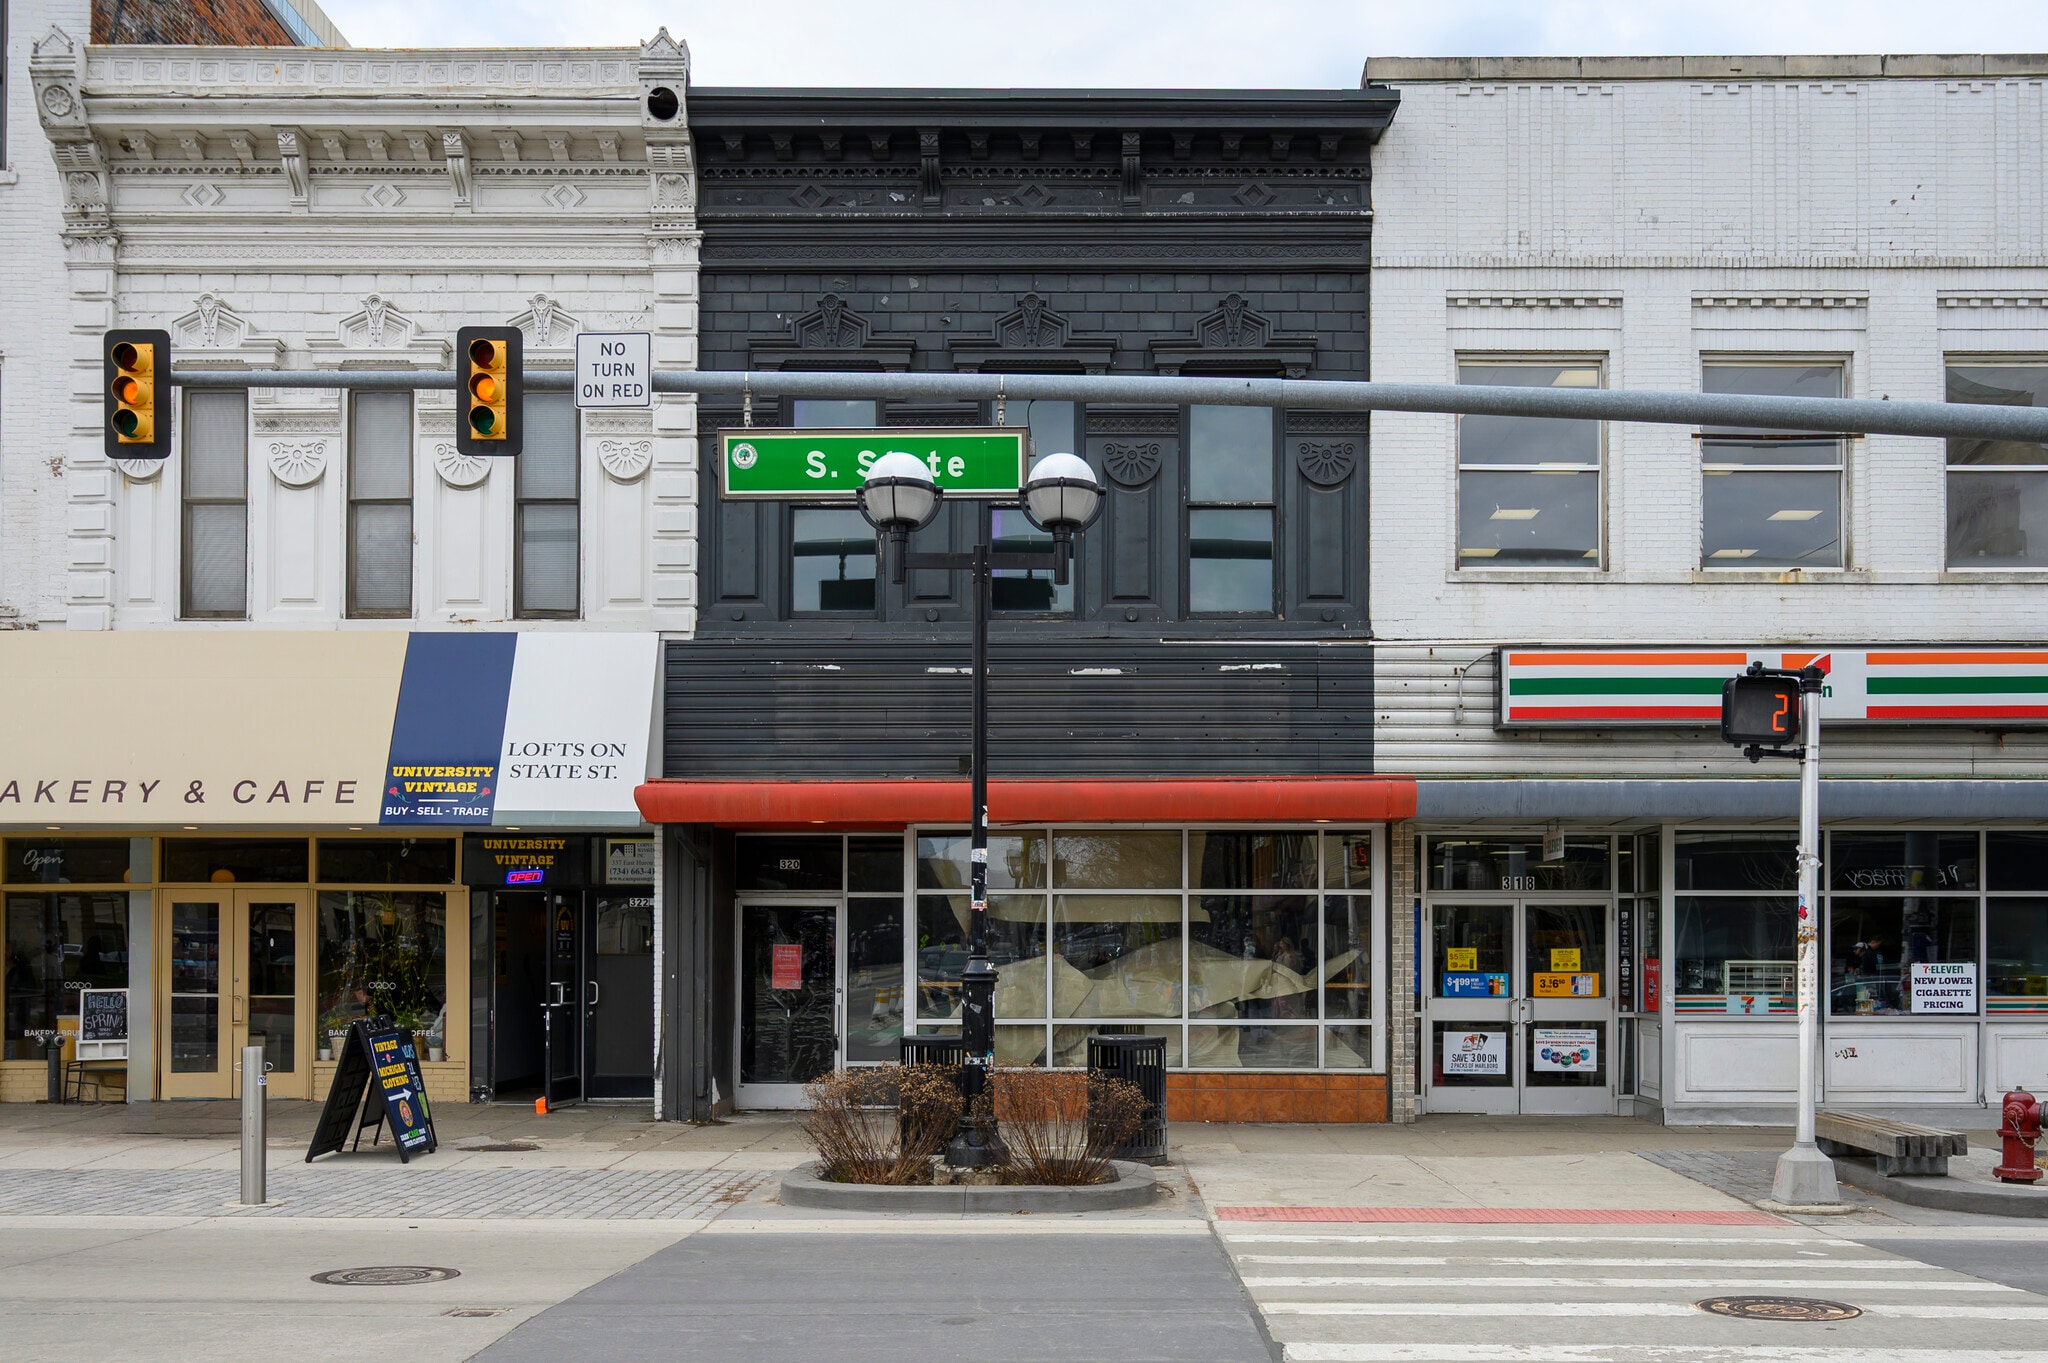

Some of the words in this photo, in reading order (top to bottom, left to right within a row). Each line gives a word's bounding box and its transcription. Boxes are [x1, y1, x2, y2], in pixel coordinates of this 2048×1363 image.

[601, 342, 626, 356] NO
[592, 363, 635, 377] TURN
[583, 384, 604, 398] ON
[612, 384, 643, 397] RED
[805, 450, 838, 479] S.
[856, 450, 966, 479] Ste
[1772, 693, 1788, 732] 2
[507, 742, 585, 758] LOFTS
[590, 743, 627, 758] ON
[392, 766, 494, 778] UNIVERSITY
[509, 764, 583, 779] STATE
[587, 765, 618, 779] ST.
[183, 779, 206, 804] &
[232, 779, 358, 804] CAFE
[404, 781, 478, 793] VINTAGE
[384, 806, 409, 816] BUY
[416, 806, 444, 816] SELL
[452, 806, 490, 816] TRADE
[483, 839, 566, 850] UNIVERSITY
[23, 849, 65, 872] Open
[494, 855, 554, 865] VINTAGE
[780, 860, 800, 869] 320
[508, 872, 541, 882] OPEN
[609, 867, 629, 875] (734)
[1502, 876, 1534, 890] 318
[630, 898, 649, 907] 322
[1914, 977, 1937, 985] NEW
[1938, 977, 1973, 985] LOWER
[1915, 989, 1972, 997] CIGARETTE
[87, 995, 124, 1009] HELLO
[1923, 1001, 1964, 1009] PRICING
[61, 1029, 80, 1037] BRU
[374, 1039, 399, 1053] VINTAGE
[1451, 1053, 1468, 1063] SAVE
[1487, 1054, 1498, 1063] ON
[378, 1062, 406, 1077] MICHIGAN
[382, 1074, 409, 1089] CLOTHING
